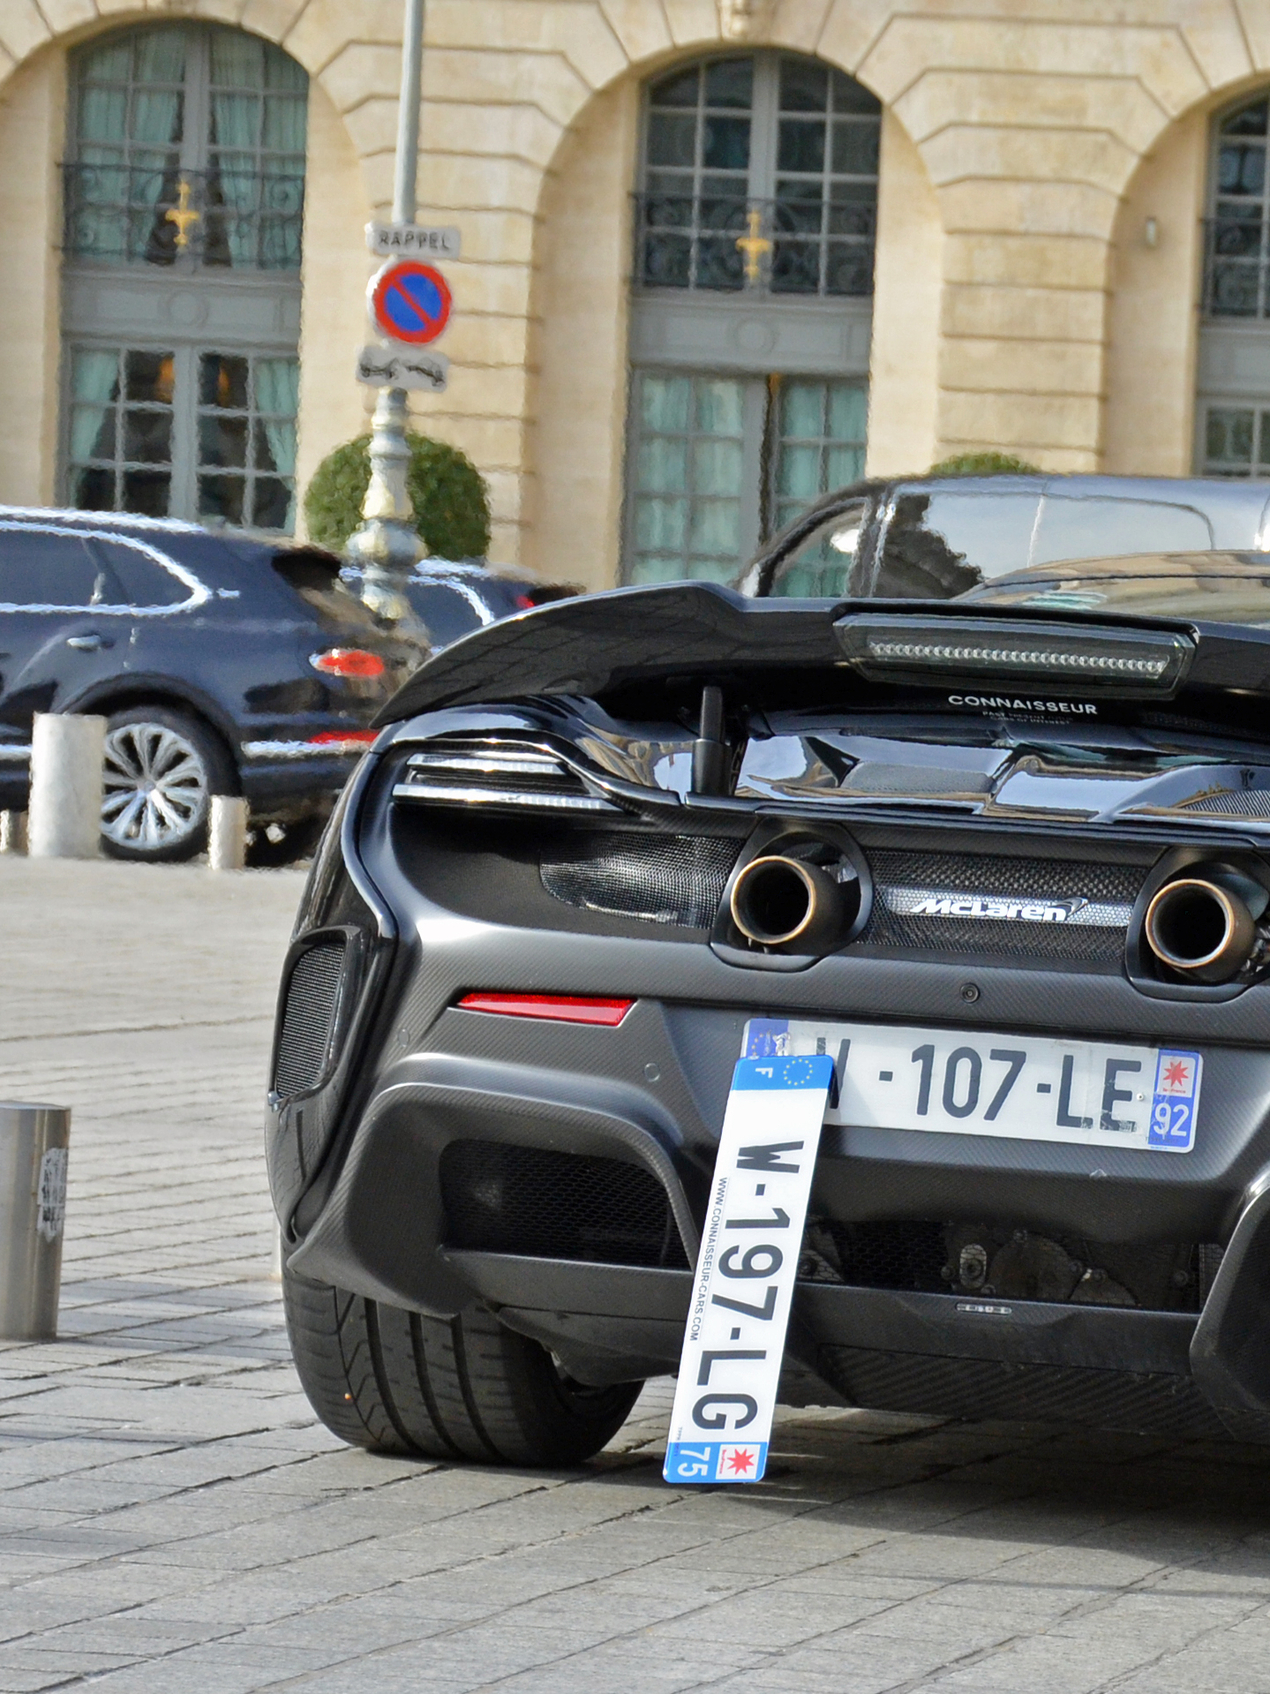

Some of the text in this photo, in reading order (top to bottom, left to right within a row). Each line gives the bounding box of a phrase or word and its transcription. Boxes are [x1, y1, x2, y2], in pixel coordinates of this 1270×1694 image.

[379, 230, 449, 250] RAPPEL
[948, 695, 1098, 715] CONNAISSEUR
[910, 899, 1067, 921] McLaren
[756, 1067, 773, 1079] F
[1153, 1103, 1189, 1137] 92
[690, 1177, 727, 1341] WWW.CONNAISSEUR-CARS.COM
[692, 1140, 804, 1430] W-197-LG
[677, 1446, 711, 1477] 75
